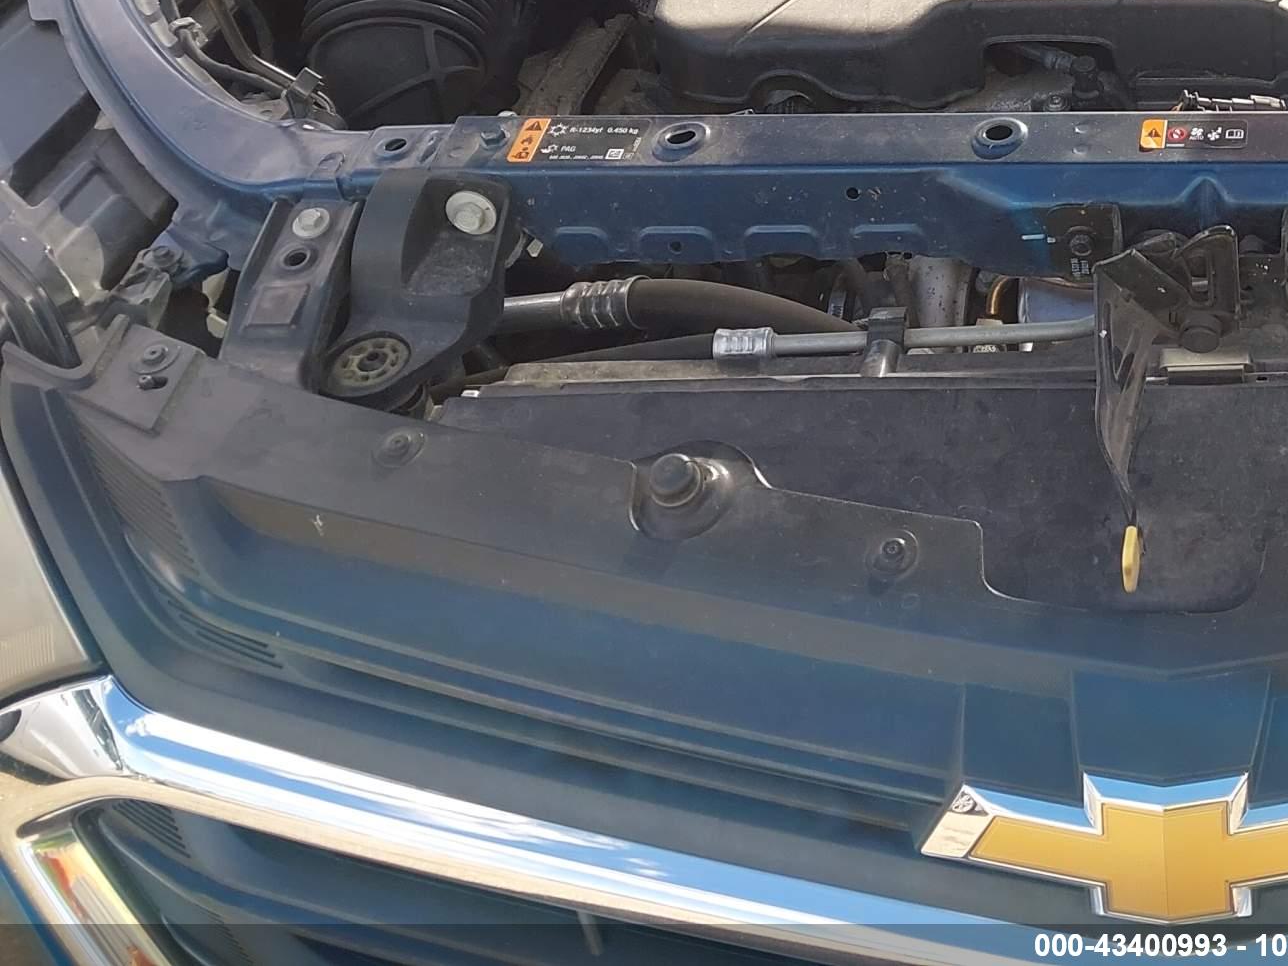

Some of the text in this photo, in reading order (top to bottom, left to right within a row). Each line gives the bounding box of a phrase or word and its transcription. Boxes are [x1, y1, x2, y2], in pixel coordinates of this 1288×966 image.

[569, 126, 639, 135] R-1234yf 0.450 kg
